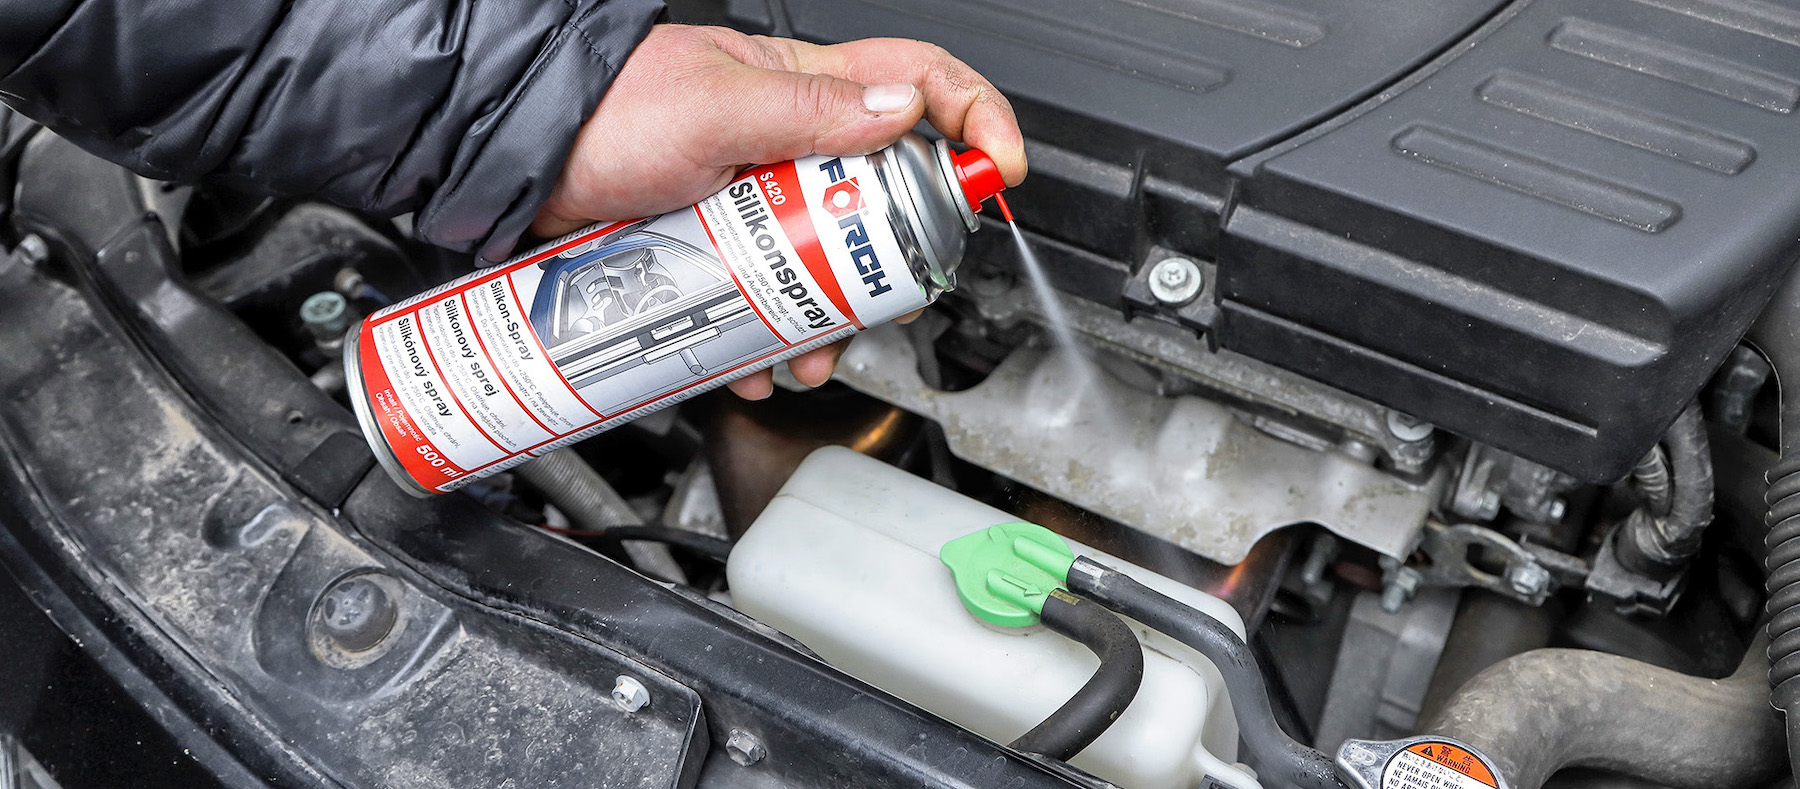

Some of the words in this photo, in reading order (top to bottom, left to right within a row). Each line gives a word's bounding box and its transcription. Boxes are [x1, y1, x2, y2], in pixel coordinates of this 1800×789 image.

[759, 171, 787, 207] S420
[703, 199, 720, 227] onserviert.
[717, 228, 727, 240] Für
[737, 265, 751, 279] und
[747, 281, 782, 324] Außenbereich.
[728, 182, 837, 329] Silikonspray
[480, 319, 488, 328] Do
[491, 280, 533, 359] Silikon-Spray
[398, 318, 430, 376] Silikónový
[424, 381, 452, 416] spray
[444, 299, 477, 357] Silikonový
[470, 362, 499, 395] sprej
[376, 393, 390, 413] Obsah
[390, 417, 406, 437] Obsah
[384, 389, 397, 407] Inhalt
[396, 410, 422, 441] Pojemność
[416, 444, 445, 467] 500
[440, 467, 463, 478] ml
[1389, 777, 1400, 787] NO
[1393, 769, 1403, 779] NE
[1404, 774, 1429, 789] JAMAIS
[1397, 761, 1420, 775] NEVER
[1422, 771, 1441, 784] OPEN
[1436, 754, 1471, 774] WARNING
